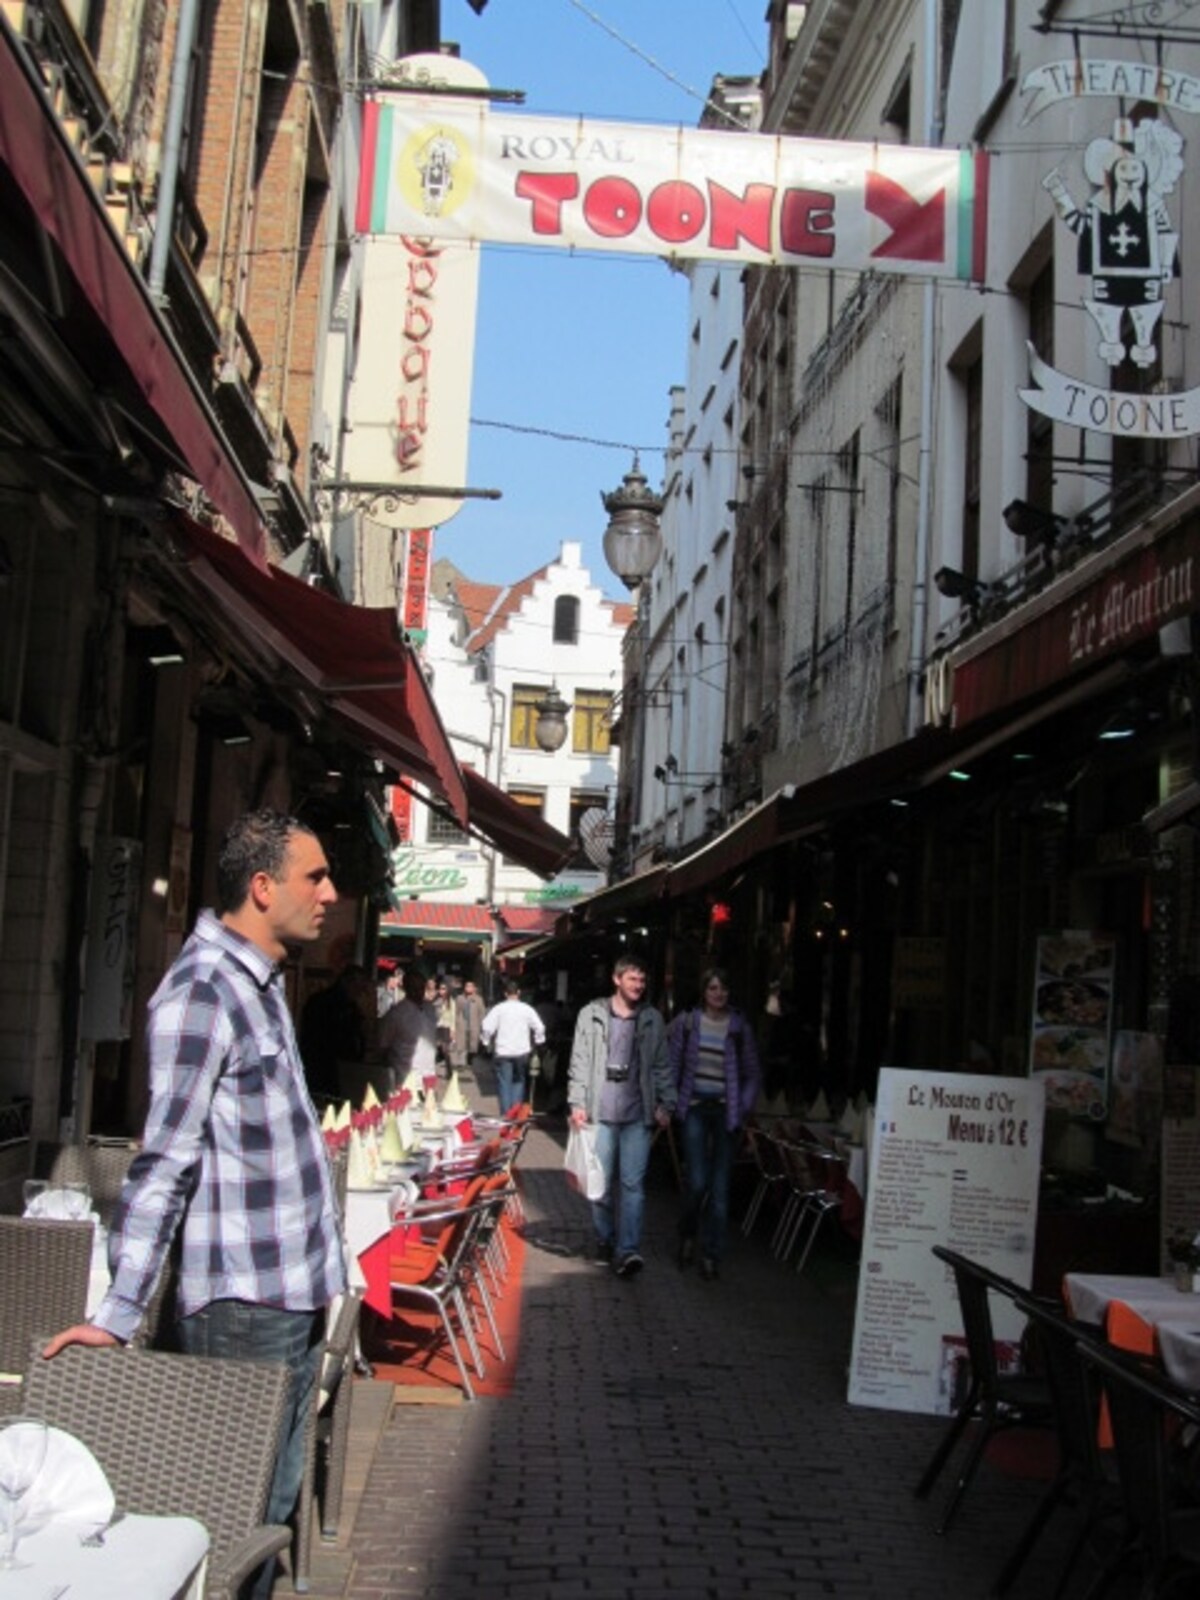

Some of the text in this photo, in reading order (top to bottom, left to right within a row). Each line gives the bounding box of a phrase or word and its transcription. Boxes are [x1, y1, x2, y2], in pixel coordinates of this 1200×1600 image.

[1042, 63, 1199, 108] THEATRE
[501, 135, 635, 164] ROYAL
[515, 171, 836, 259] TOONE
[1065, 384, 1188, 432] TOONE
[908, 1084, 1016, 1113] Le Mouton d'Or
[947, 1113, 985, 1144] Menu
[998, 1117, 1016, 1147] 12
[1018, 1119, 1029, 1148] €
